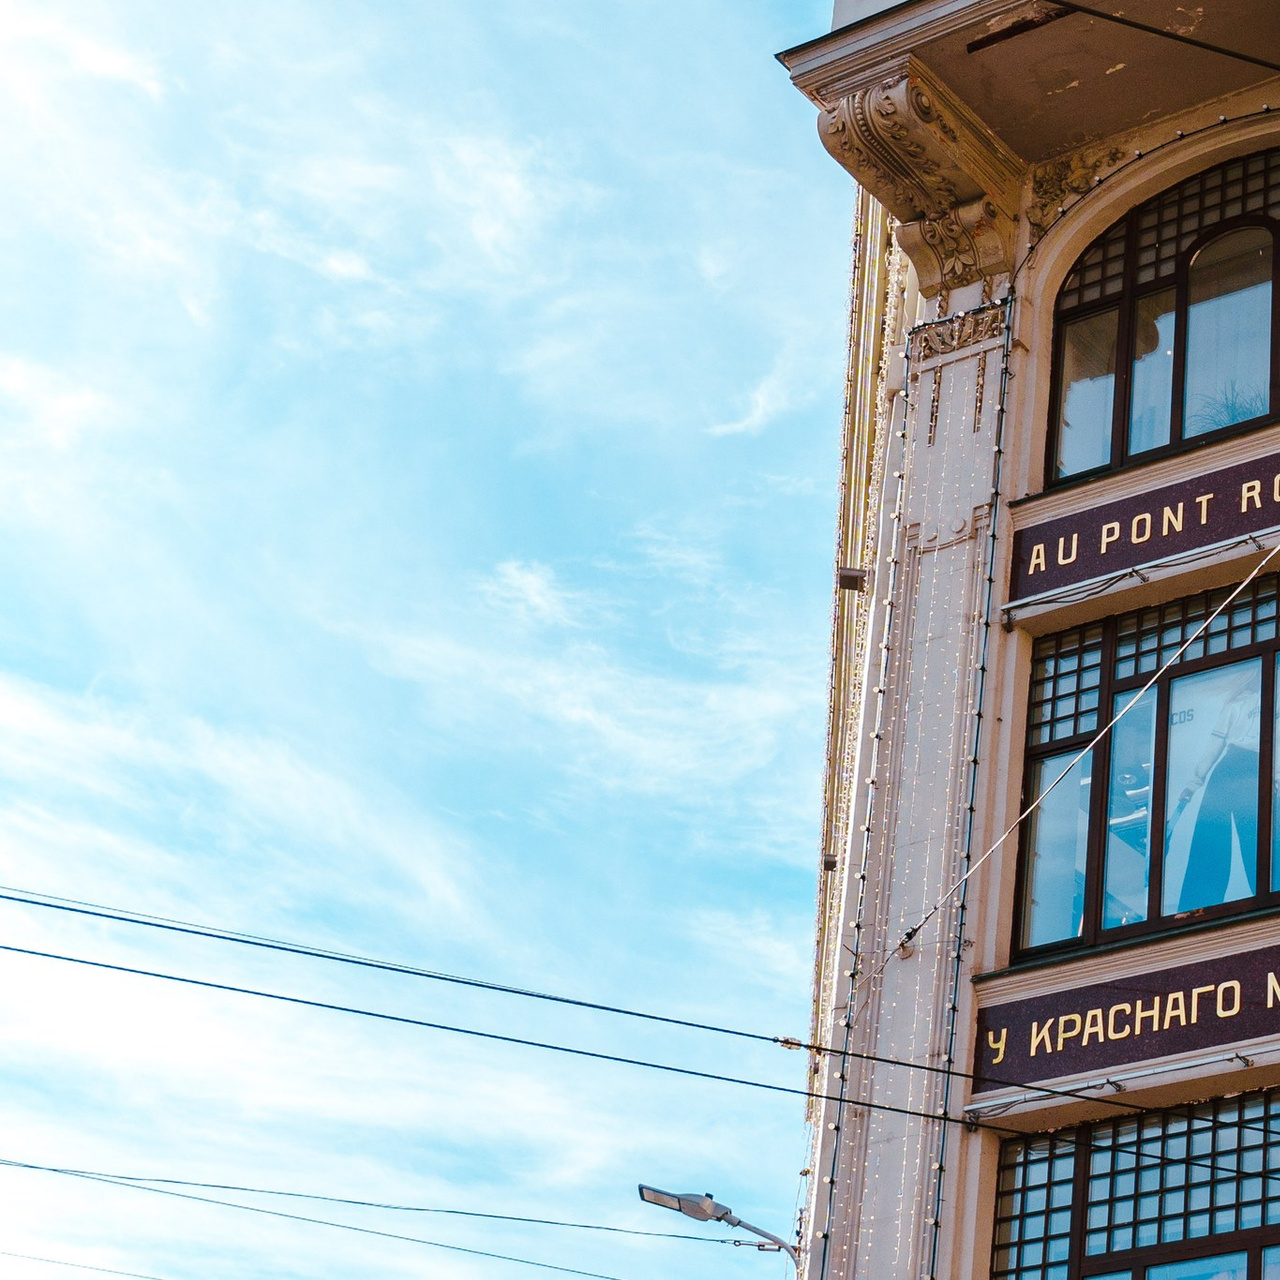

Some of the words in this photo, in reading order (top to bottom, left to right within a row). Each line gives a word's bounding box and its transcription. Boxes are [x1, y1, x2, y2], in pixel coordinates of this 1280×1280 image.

[1027, 532, 1079, 575] AU
[1100, 493, 1214, 554] PONT
[988, 1027, 1008, 1065] У
[1029, 979, 1241, 1057] КРАСНАГО
